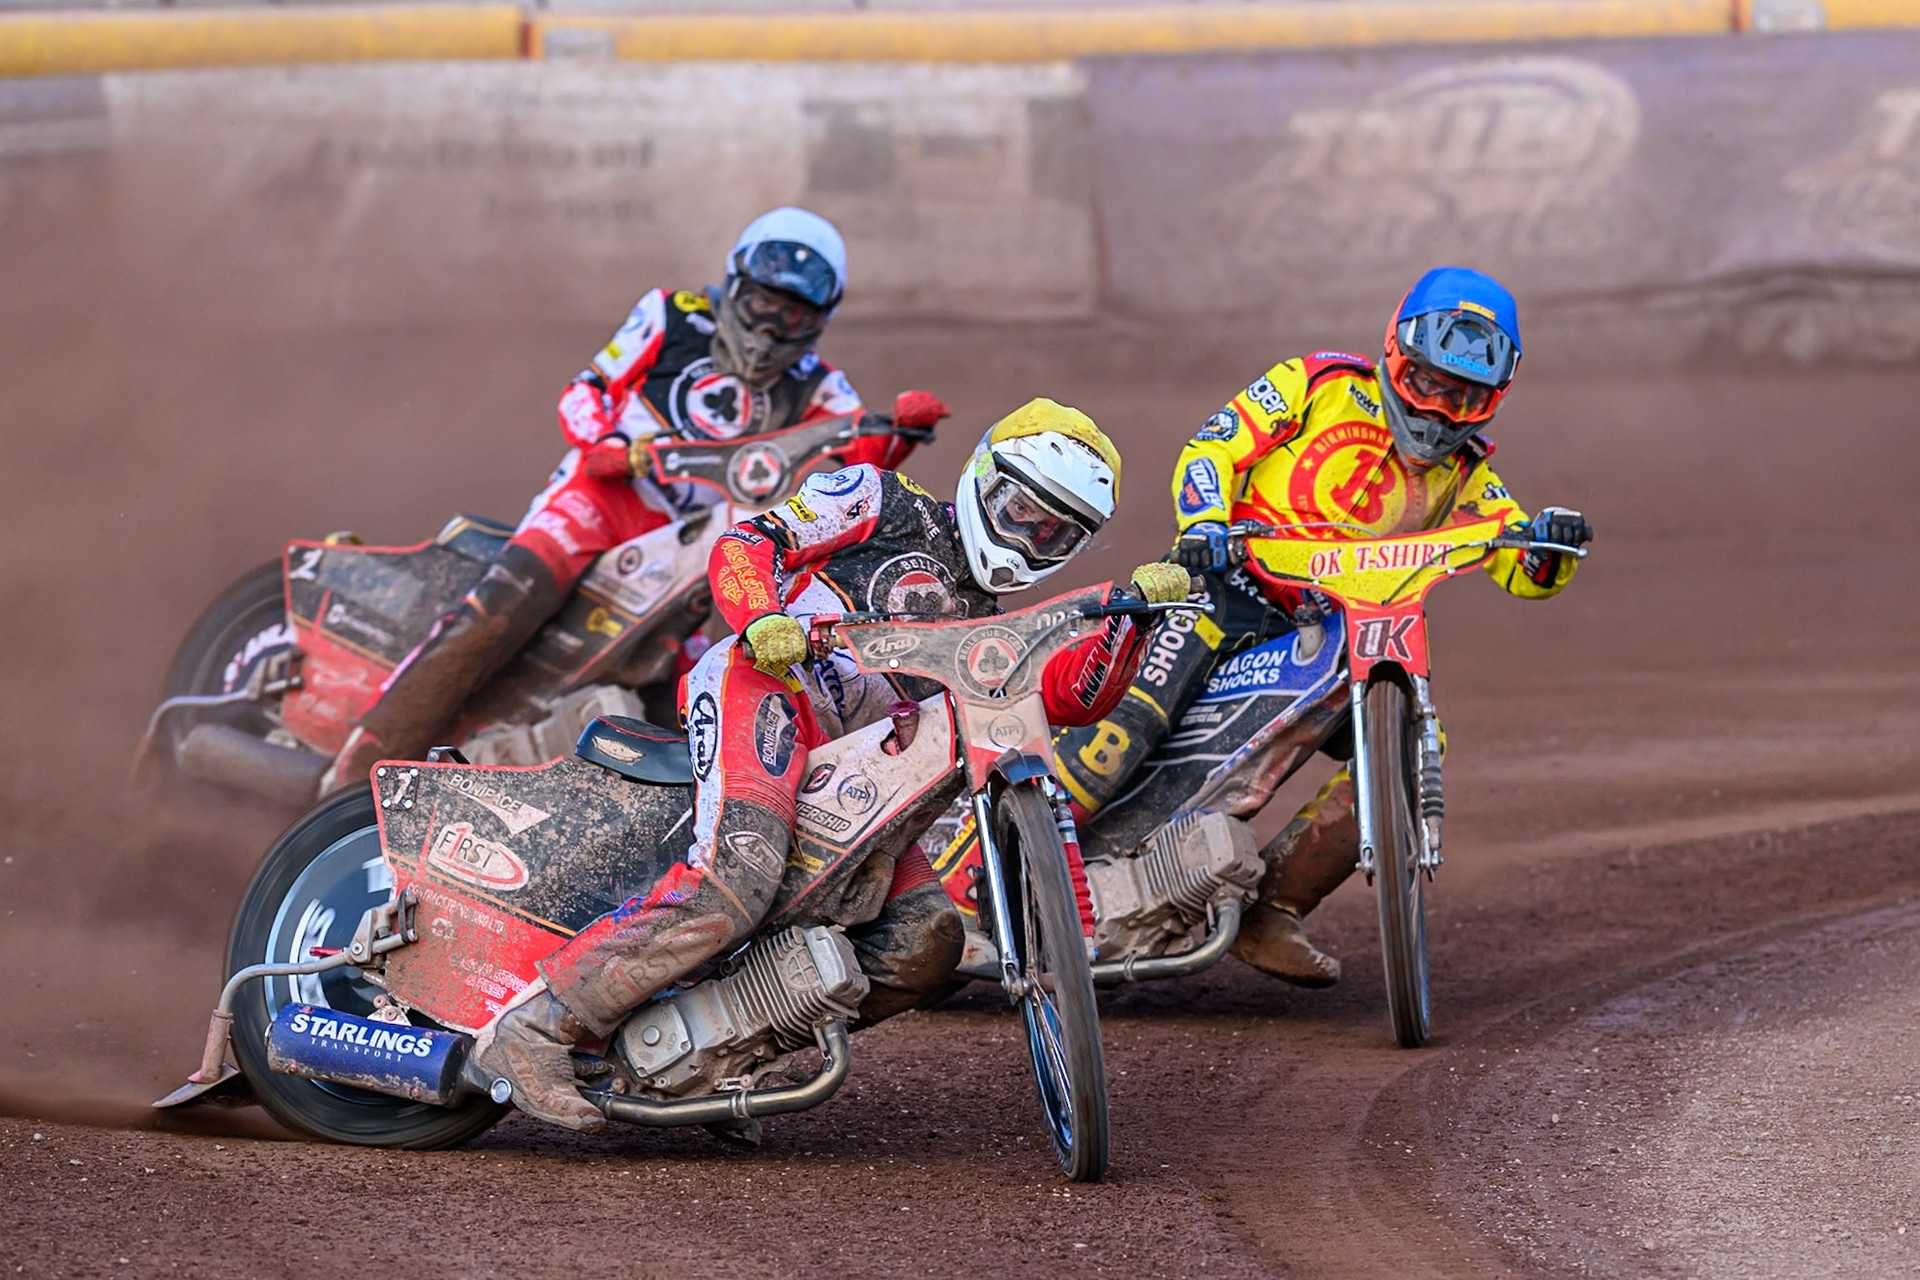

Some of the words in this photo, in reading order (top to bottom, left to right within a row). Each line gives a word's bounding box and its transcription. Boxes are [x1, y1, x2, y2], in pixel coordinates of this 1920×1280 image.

[1247, 376, 1289, 416] ger
[1348, 384, 1380, 413] ROWE
[1329, 448, 1396, 525] B
[914, 498, 941, 538] ROWE
[900, 558, 940, 576] BELLE
[1309, 549, 1343, 578] OK
[1356, 544, 1453, 571] T-SHIRT
[872, 636, 916, 655] Arai
[959, 633, 979, 661] BELLE
[980, 628, 1000, 638] VUE
[1206, 668, 1281, 694] SHOCKS
[693, 703, 715, 776] Arai
[761, 711, 781, 766] BONIFACE
[1078, 719, 1131, 775] B
[450, 774, 524, 812] BONIFACE
[290, 1013, 433, 1058] STARLINGS
[311, 1037, 404, 1063] TRANSPORT
